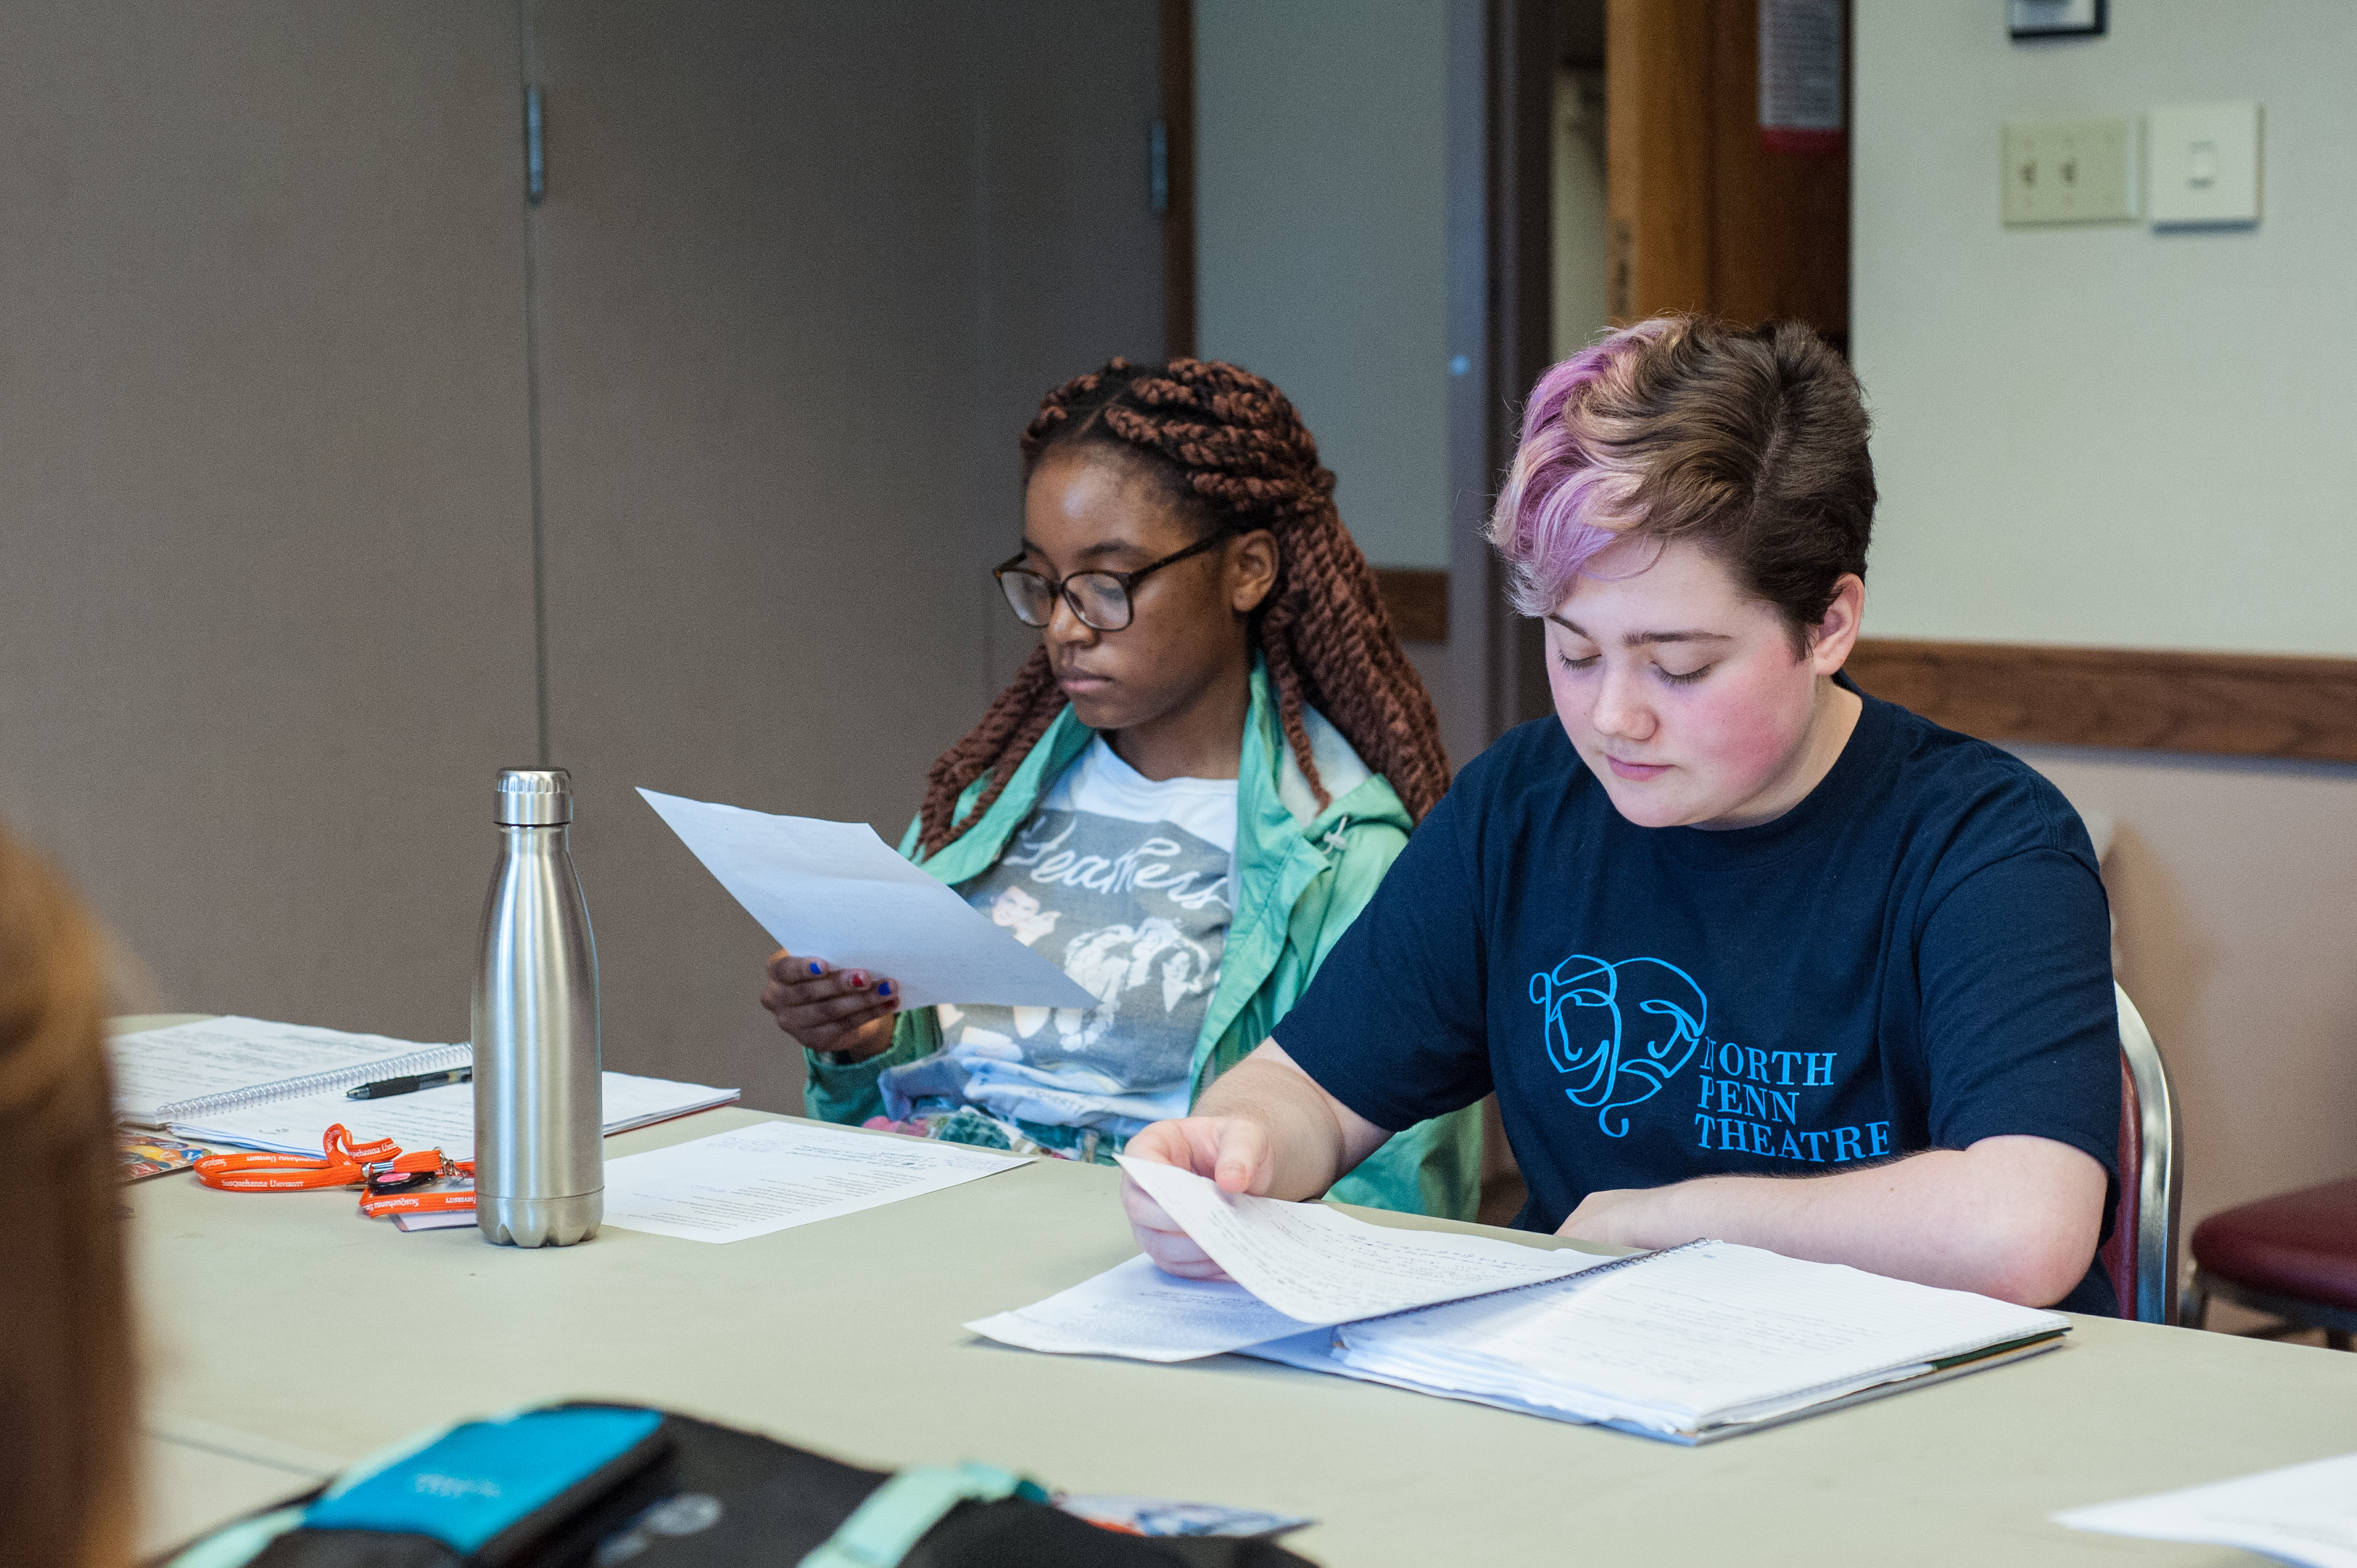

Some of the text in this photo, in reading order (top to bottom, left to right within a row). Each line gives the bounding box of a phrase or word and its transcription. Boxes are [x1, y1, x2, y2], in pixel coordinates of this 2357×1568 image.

[1699, 1036, 1837, 1087] NORTH
[1697, 1074, 1800, 1125] PENN
[1695, 1113, 1890, 1162] THEATRE
